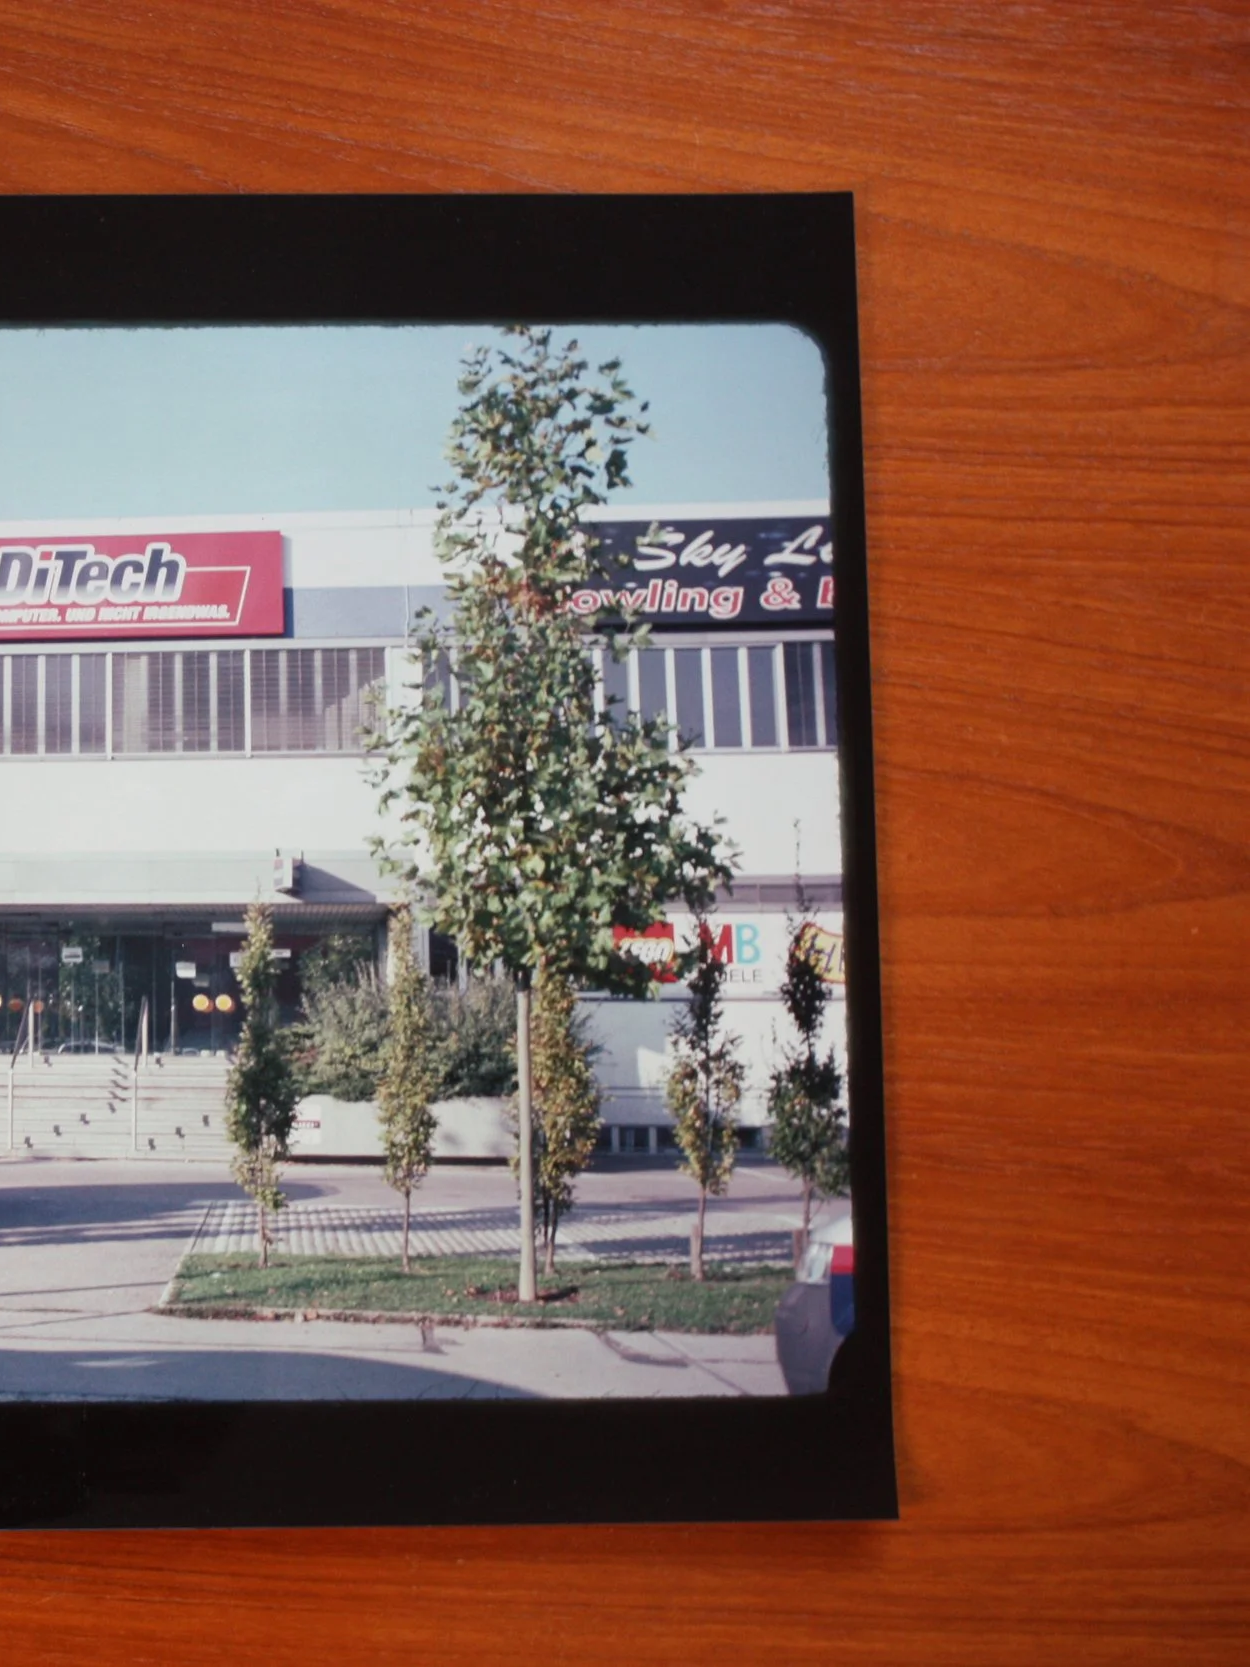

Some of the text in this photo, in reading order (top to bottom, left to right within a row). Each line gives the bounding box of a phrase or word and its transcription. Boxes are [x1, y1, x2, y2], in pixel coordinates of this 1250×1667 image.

[633, 529, 746, 578] Sky
[554, 577, 744, 619] owling
[760, 576, 801, 611] &
